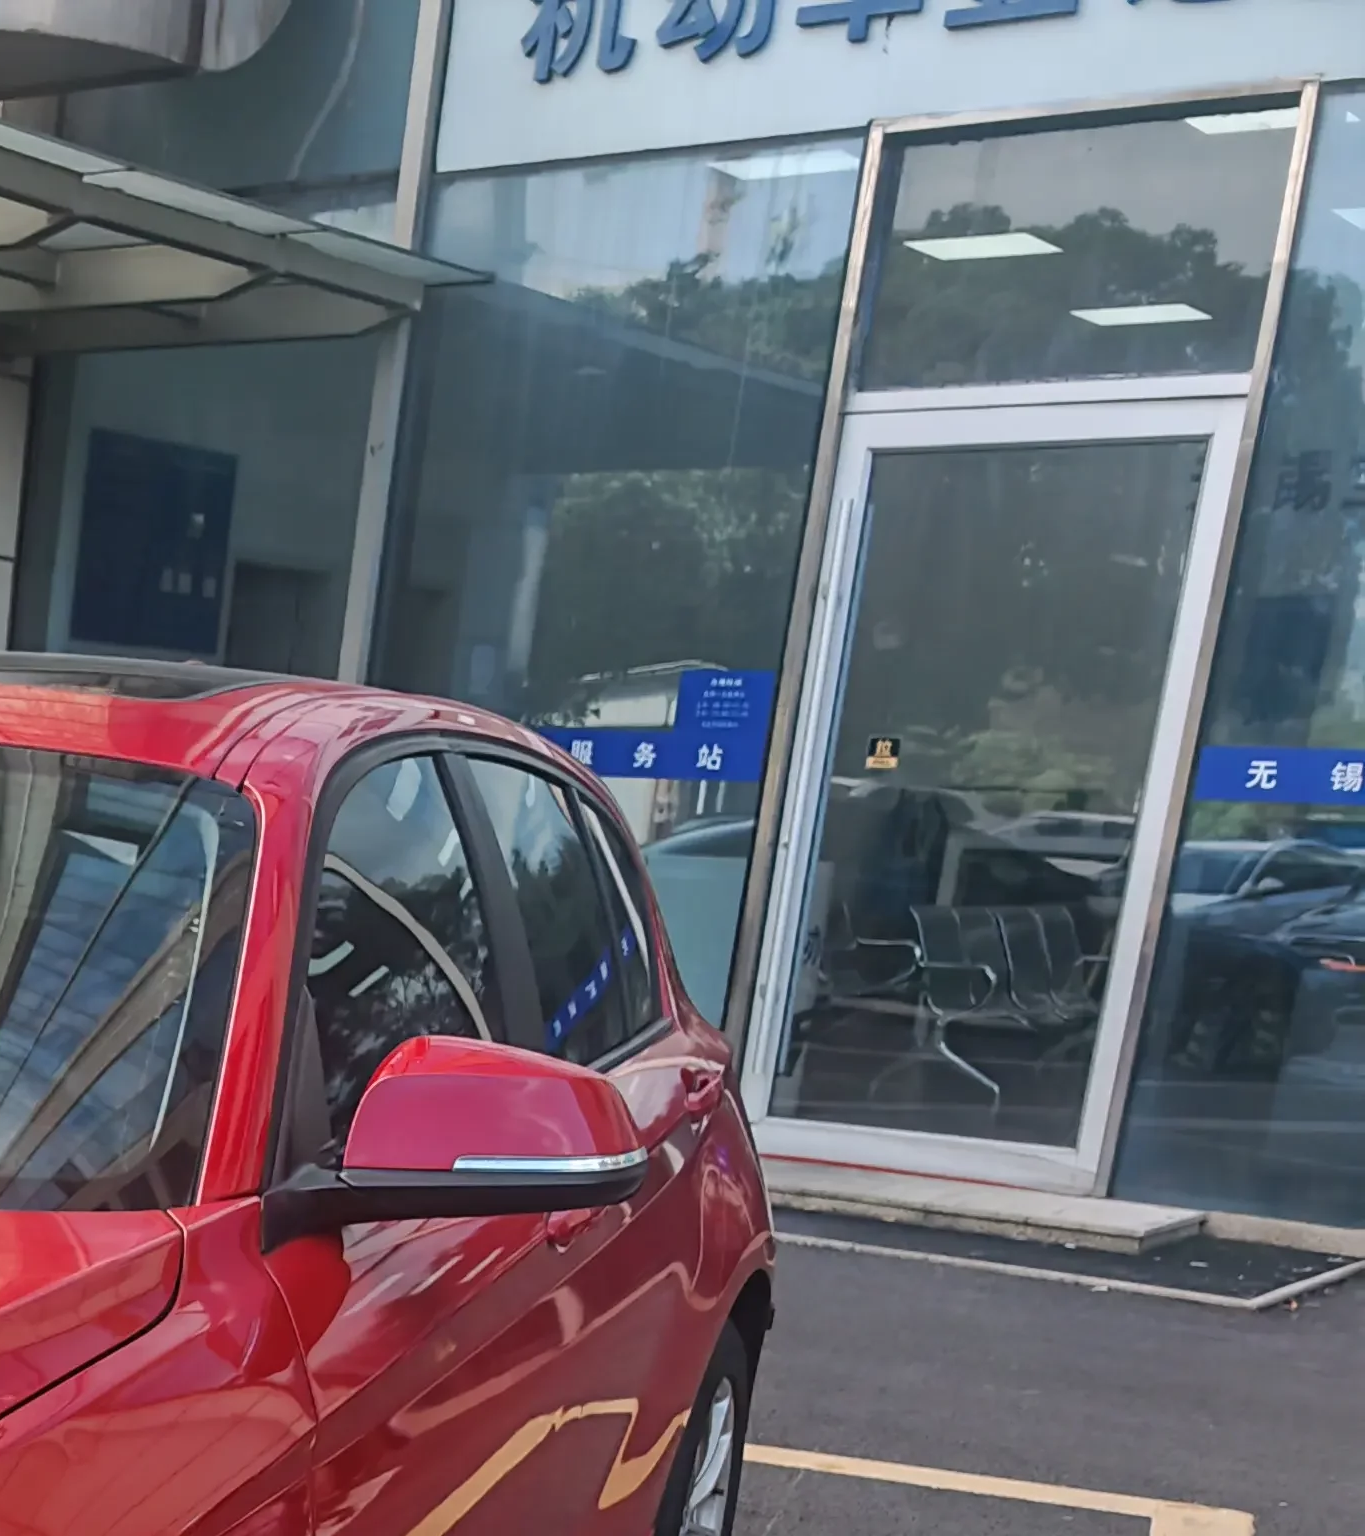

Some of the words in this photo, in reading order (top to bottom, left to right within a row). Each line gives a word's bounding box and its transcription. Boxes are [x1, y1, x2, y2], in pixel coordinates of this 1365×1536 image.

[571, 740, 724, 771] 服务站
[1245, 760, 1364, 792] 无锡
